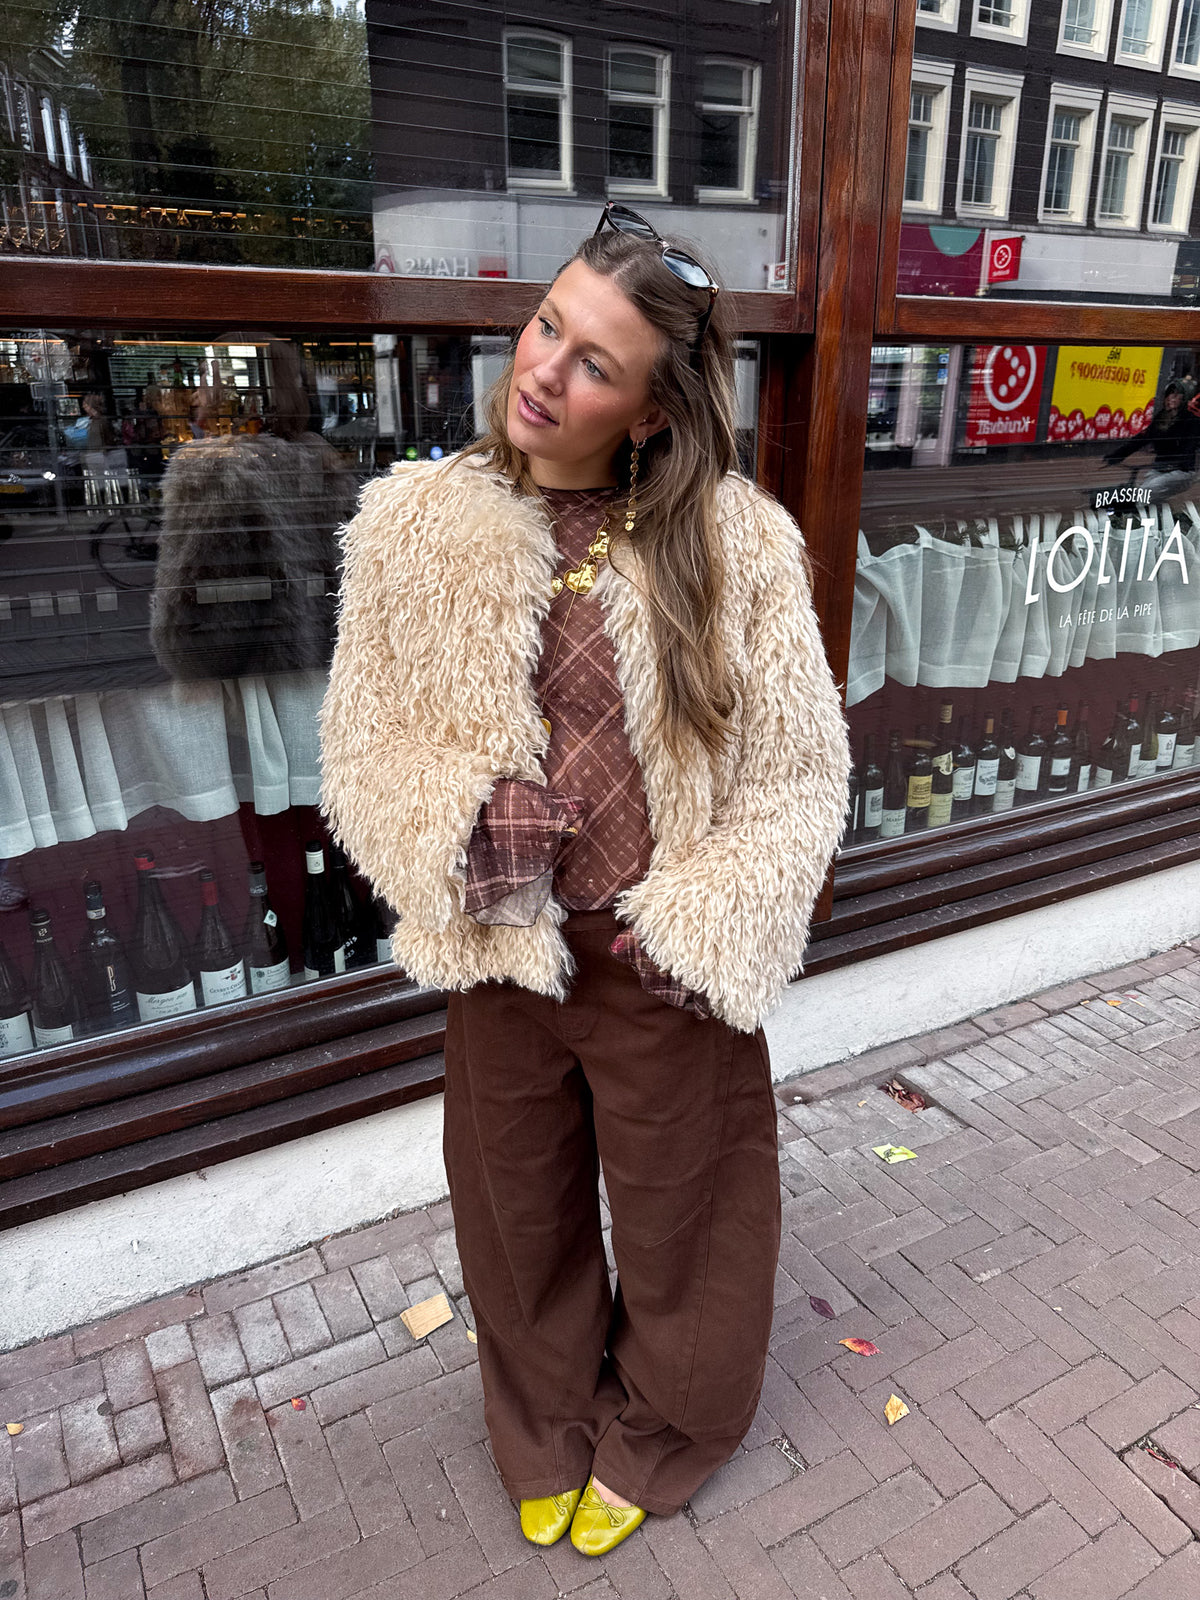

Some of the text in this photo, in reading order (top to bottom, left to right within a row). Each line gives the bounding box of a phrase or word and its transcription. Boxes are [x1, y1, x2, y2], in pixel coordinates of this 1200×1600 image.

[1095, 487, 1153, 509] BRASSERIE
[1024, 517, 1190, 606] LOLITA
[1059, 602, 1153, 629] LA FÊTE DE LA PIPE
